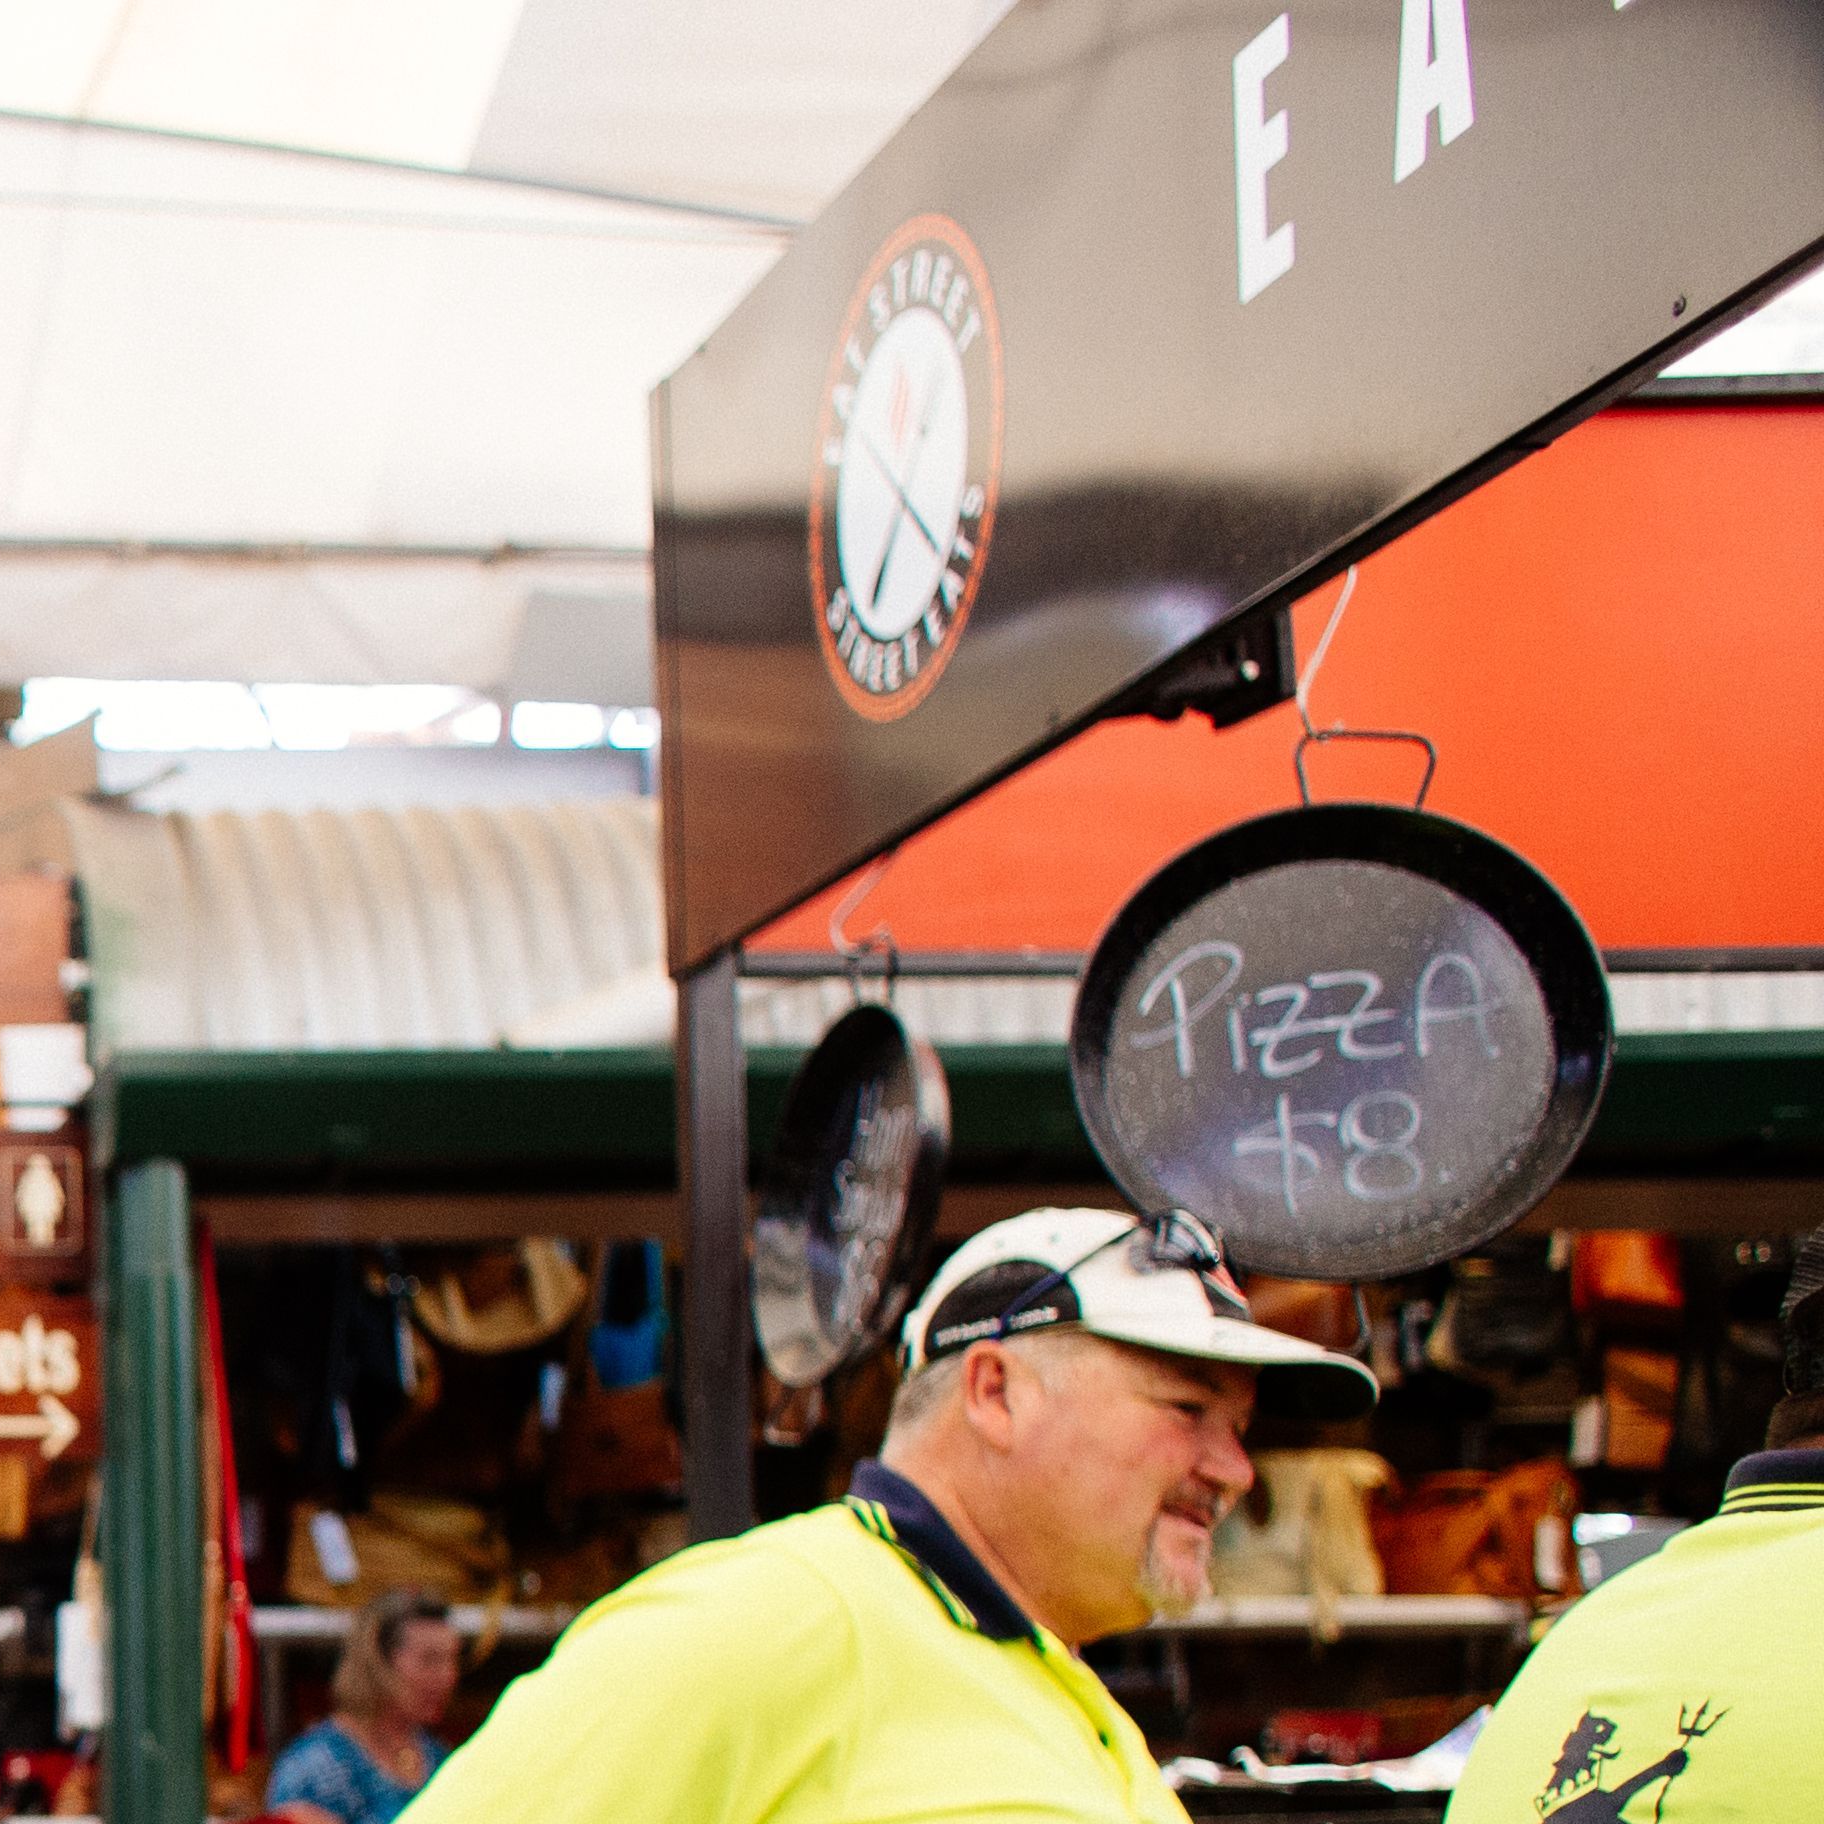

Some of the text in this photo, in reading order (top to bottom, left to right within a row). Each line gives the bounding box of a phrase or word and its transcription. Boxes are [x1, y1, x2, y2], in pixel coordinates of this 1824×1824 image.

[867, 249, 983, 354] STREET
[825, 484, 985, 692] STREET EATS
[1232, 1090, 1422, 1216] $8
